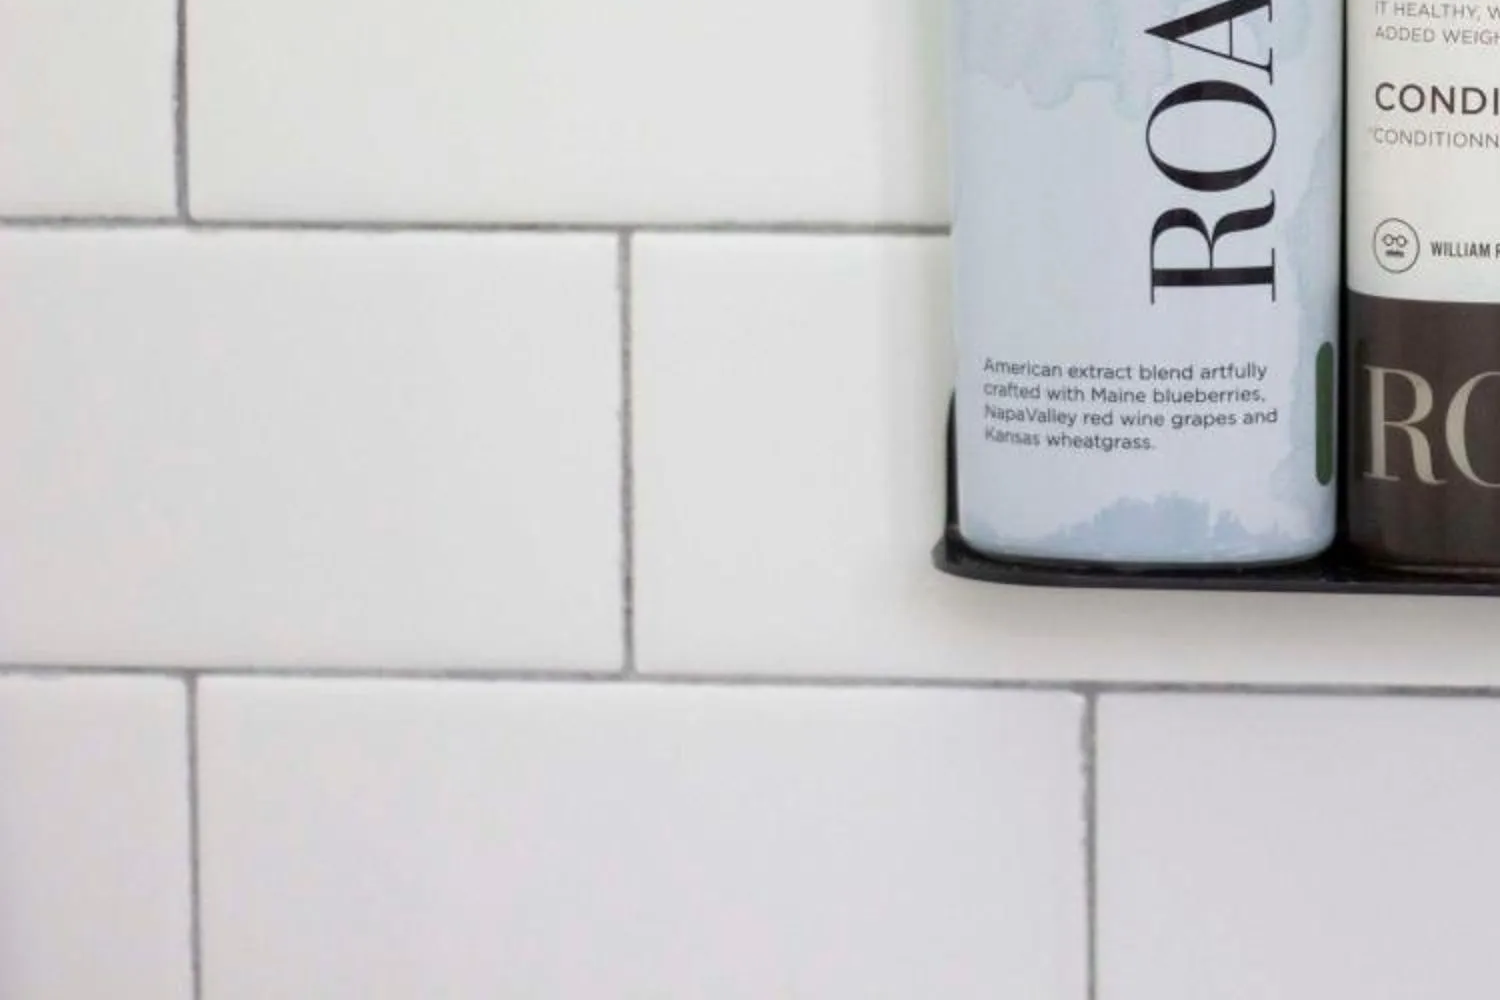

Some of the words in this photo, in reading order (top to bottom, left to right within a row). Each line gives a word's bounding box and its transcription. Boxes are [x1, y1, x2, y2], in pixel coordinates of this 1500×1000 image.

[1375, 1, 1387, 17] IT
[1393, 2, 1481, 21] HEALTHY,
[1375, 25, 1435, 43] ADDED
[1430, 241, 1491, 258] WILLIAM
[983, 358, 1062, 378] American
[1068, 364, 1132, 380] extract
[1139, 364, 1193, 381] blend
[1200, 362, 1268, 382] artfully
[983, 382, 1041, 400] crafted
[1048, 386, 1086, 401] with
[1092, 387, 1146, 402] Maine
[983, 404, 1076, 428] NapaValley
[1084, 411, 1114, 426] red
[1121, 412, 1164, 427] wine
[1171, 412, 1237, 429] grapes
[1242, 409, 1278, 424] and
[984, 428, 1041, 446] Kansas
[1048, 432, 1156, 452] wheatgrass.
